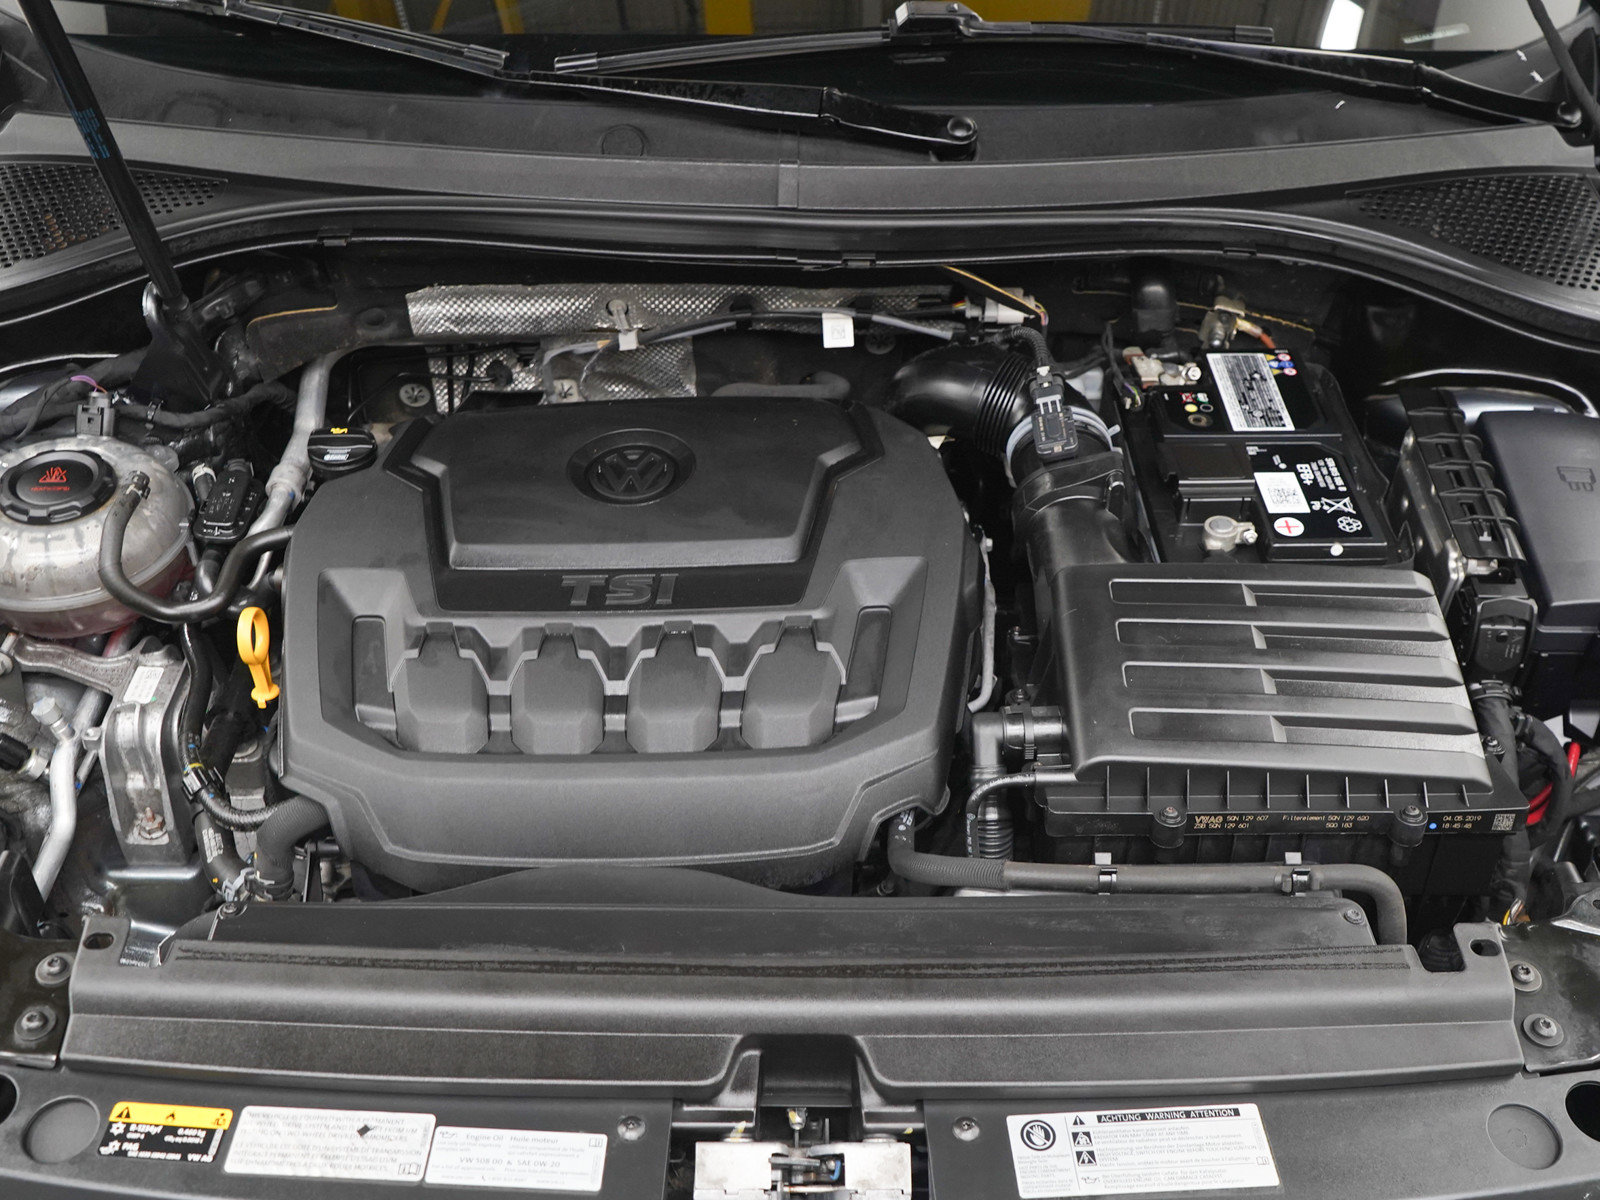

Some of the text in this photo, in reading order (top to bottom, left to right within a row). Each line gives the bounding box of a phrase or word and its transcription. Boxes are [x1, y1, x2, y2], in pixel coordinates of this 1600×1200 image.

[561, 573, 679, 606] TSI
[1101, 1109, 1235, 1123] ACHTUNG WARNING ATTENTION
[465, 1133, 490, 1141] Engine
